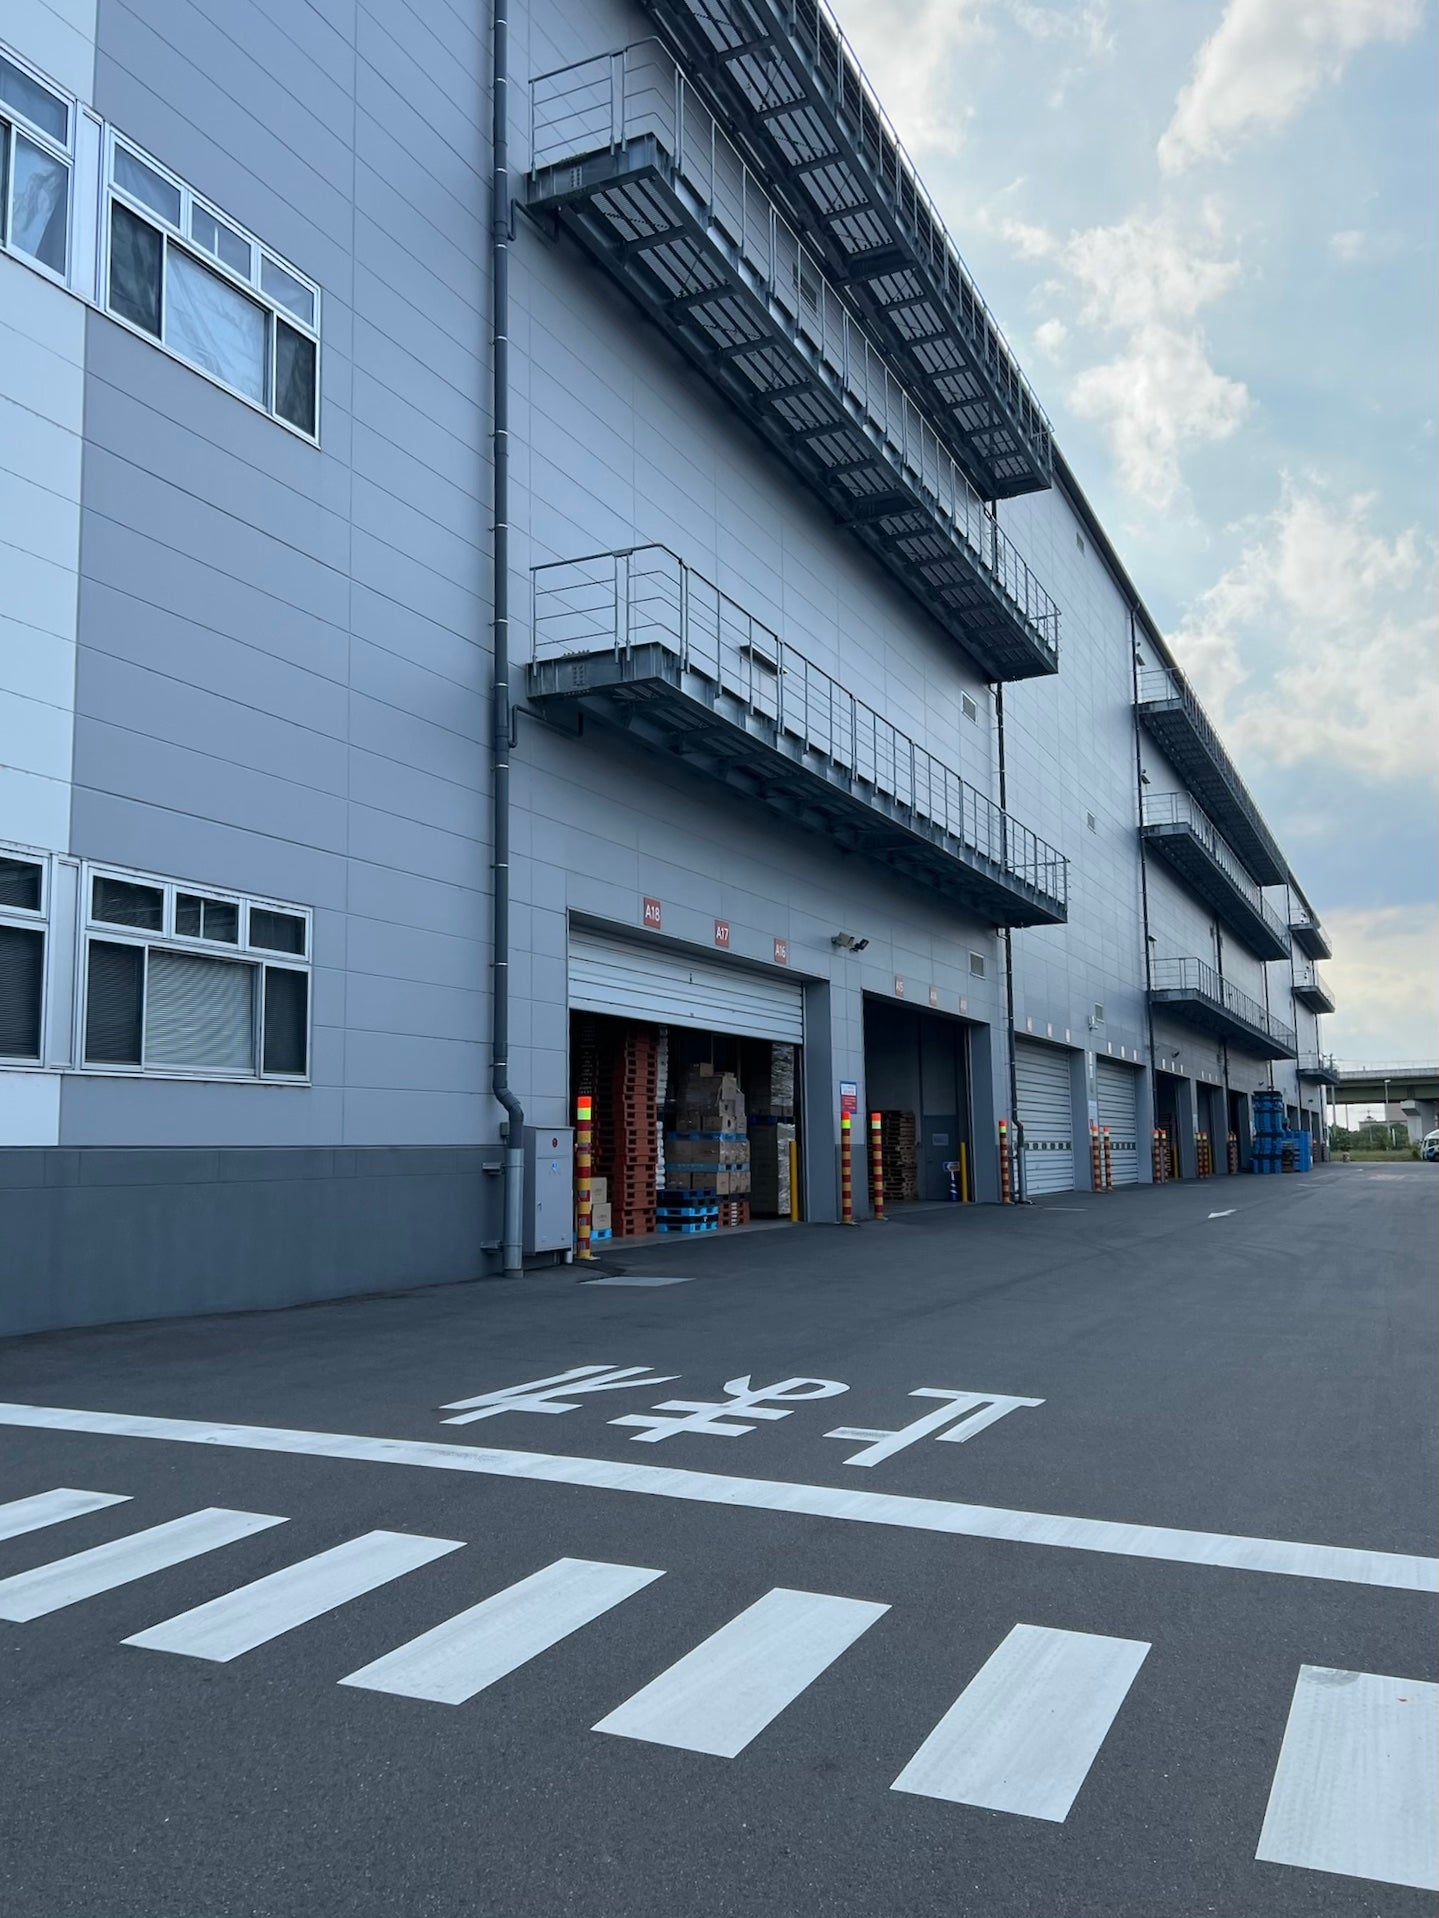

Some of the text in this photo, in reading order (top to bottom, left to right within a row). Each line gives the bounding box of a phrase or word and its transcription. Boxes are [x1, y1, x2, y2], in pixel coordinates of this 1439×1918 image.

[645, 904, 660, 922] A18
[716, 926, 729, 941] A17
[775, 944, 786, 958] A16
[440, 1364, 1046, 1467] 止まれ
